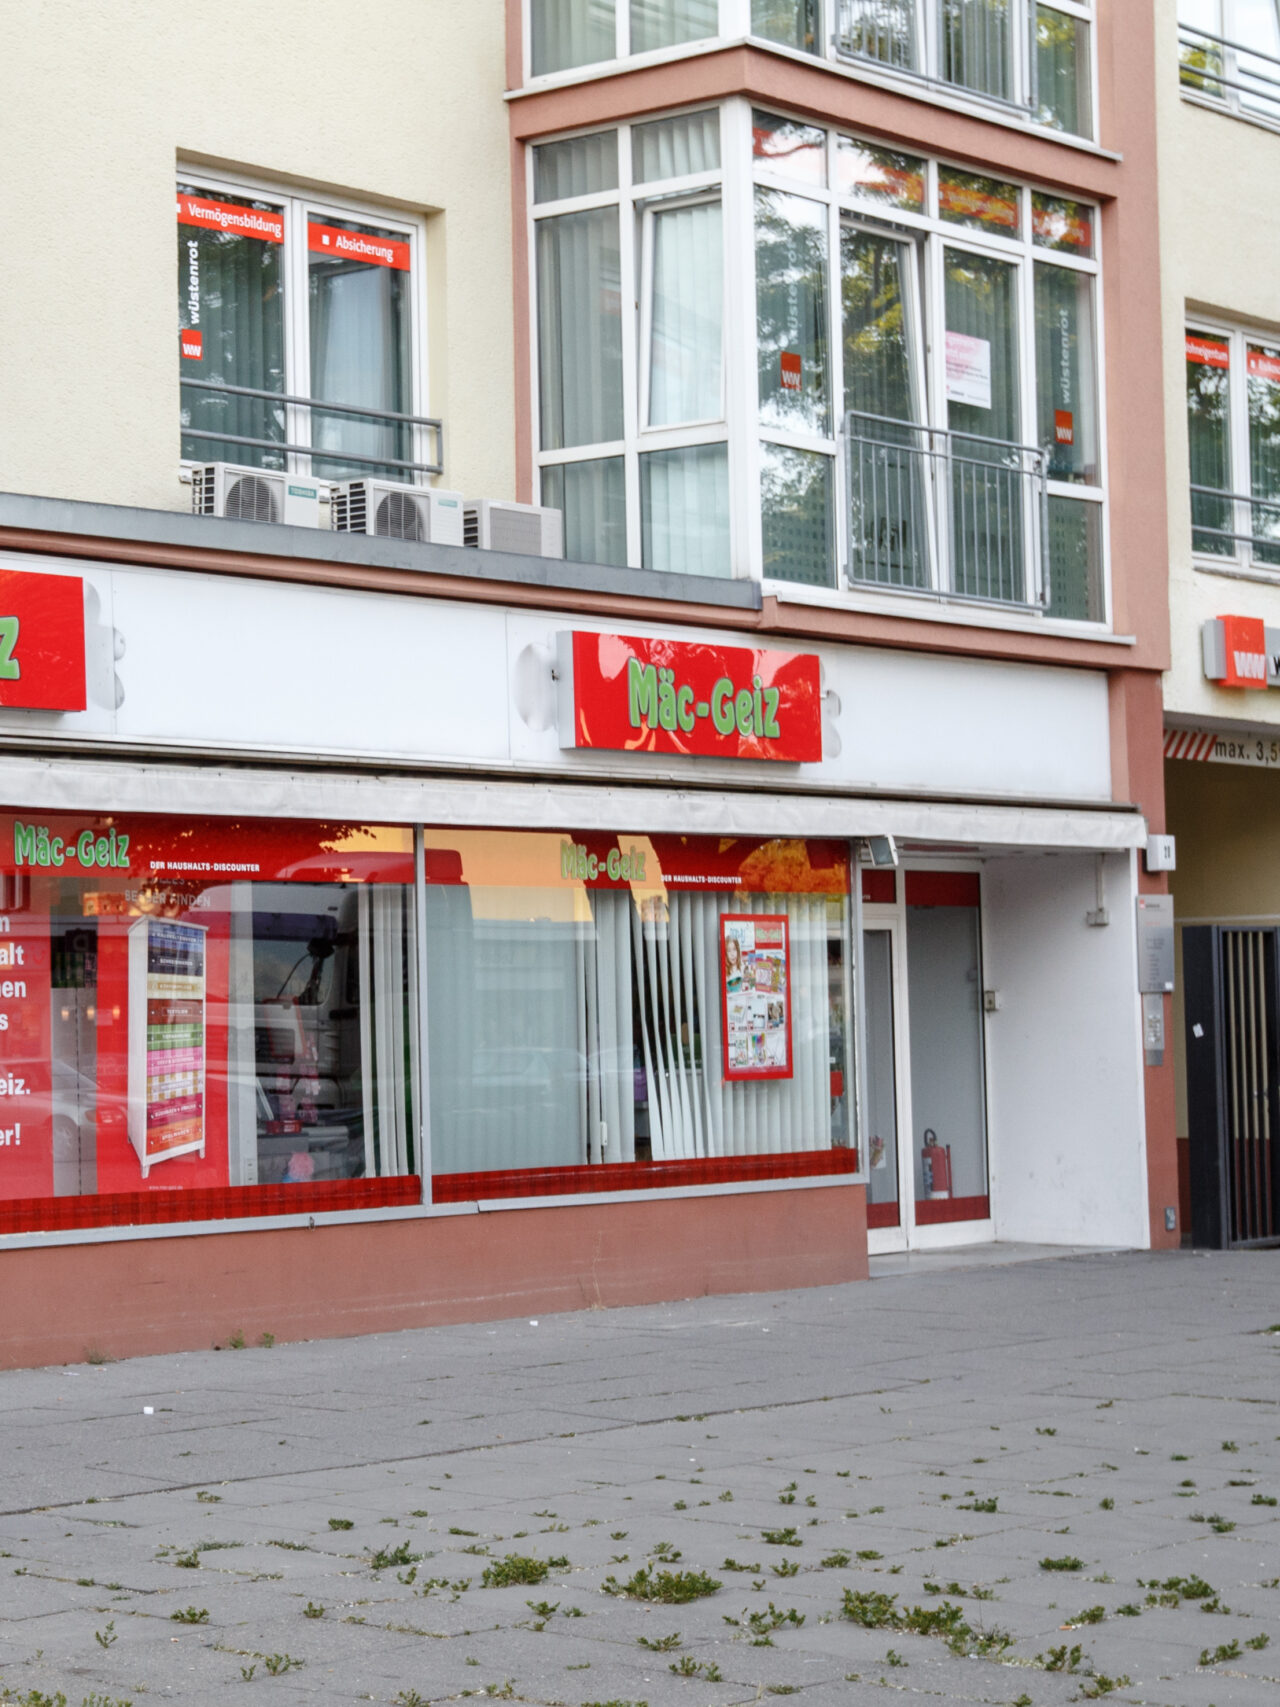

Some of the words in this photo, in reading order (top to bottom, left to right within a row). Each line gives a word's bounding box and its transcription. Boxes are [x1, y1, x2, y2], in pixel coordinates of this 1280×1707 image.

[188, 203, 282, 238] Vermögensbildung
[335, 235, 393, 263] Absicherung
[188, 240, 200, 325] wüstenrot
[1059, 309, 1071, 404] wüstenrot
[628, 656, 780, 738] Mäc-Geiz
[1215, 741, 1250, 761] max.
[14, 821, 130, 868] Mäc-Geiz
[560, 839, 646, 881] Mäc-Geiz
[150, 861, 165, 870] DER
[661, 874, 672, 882] DER
[125, 889, 166, 904] BEER
